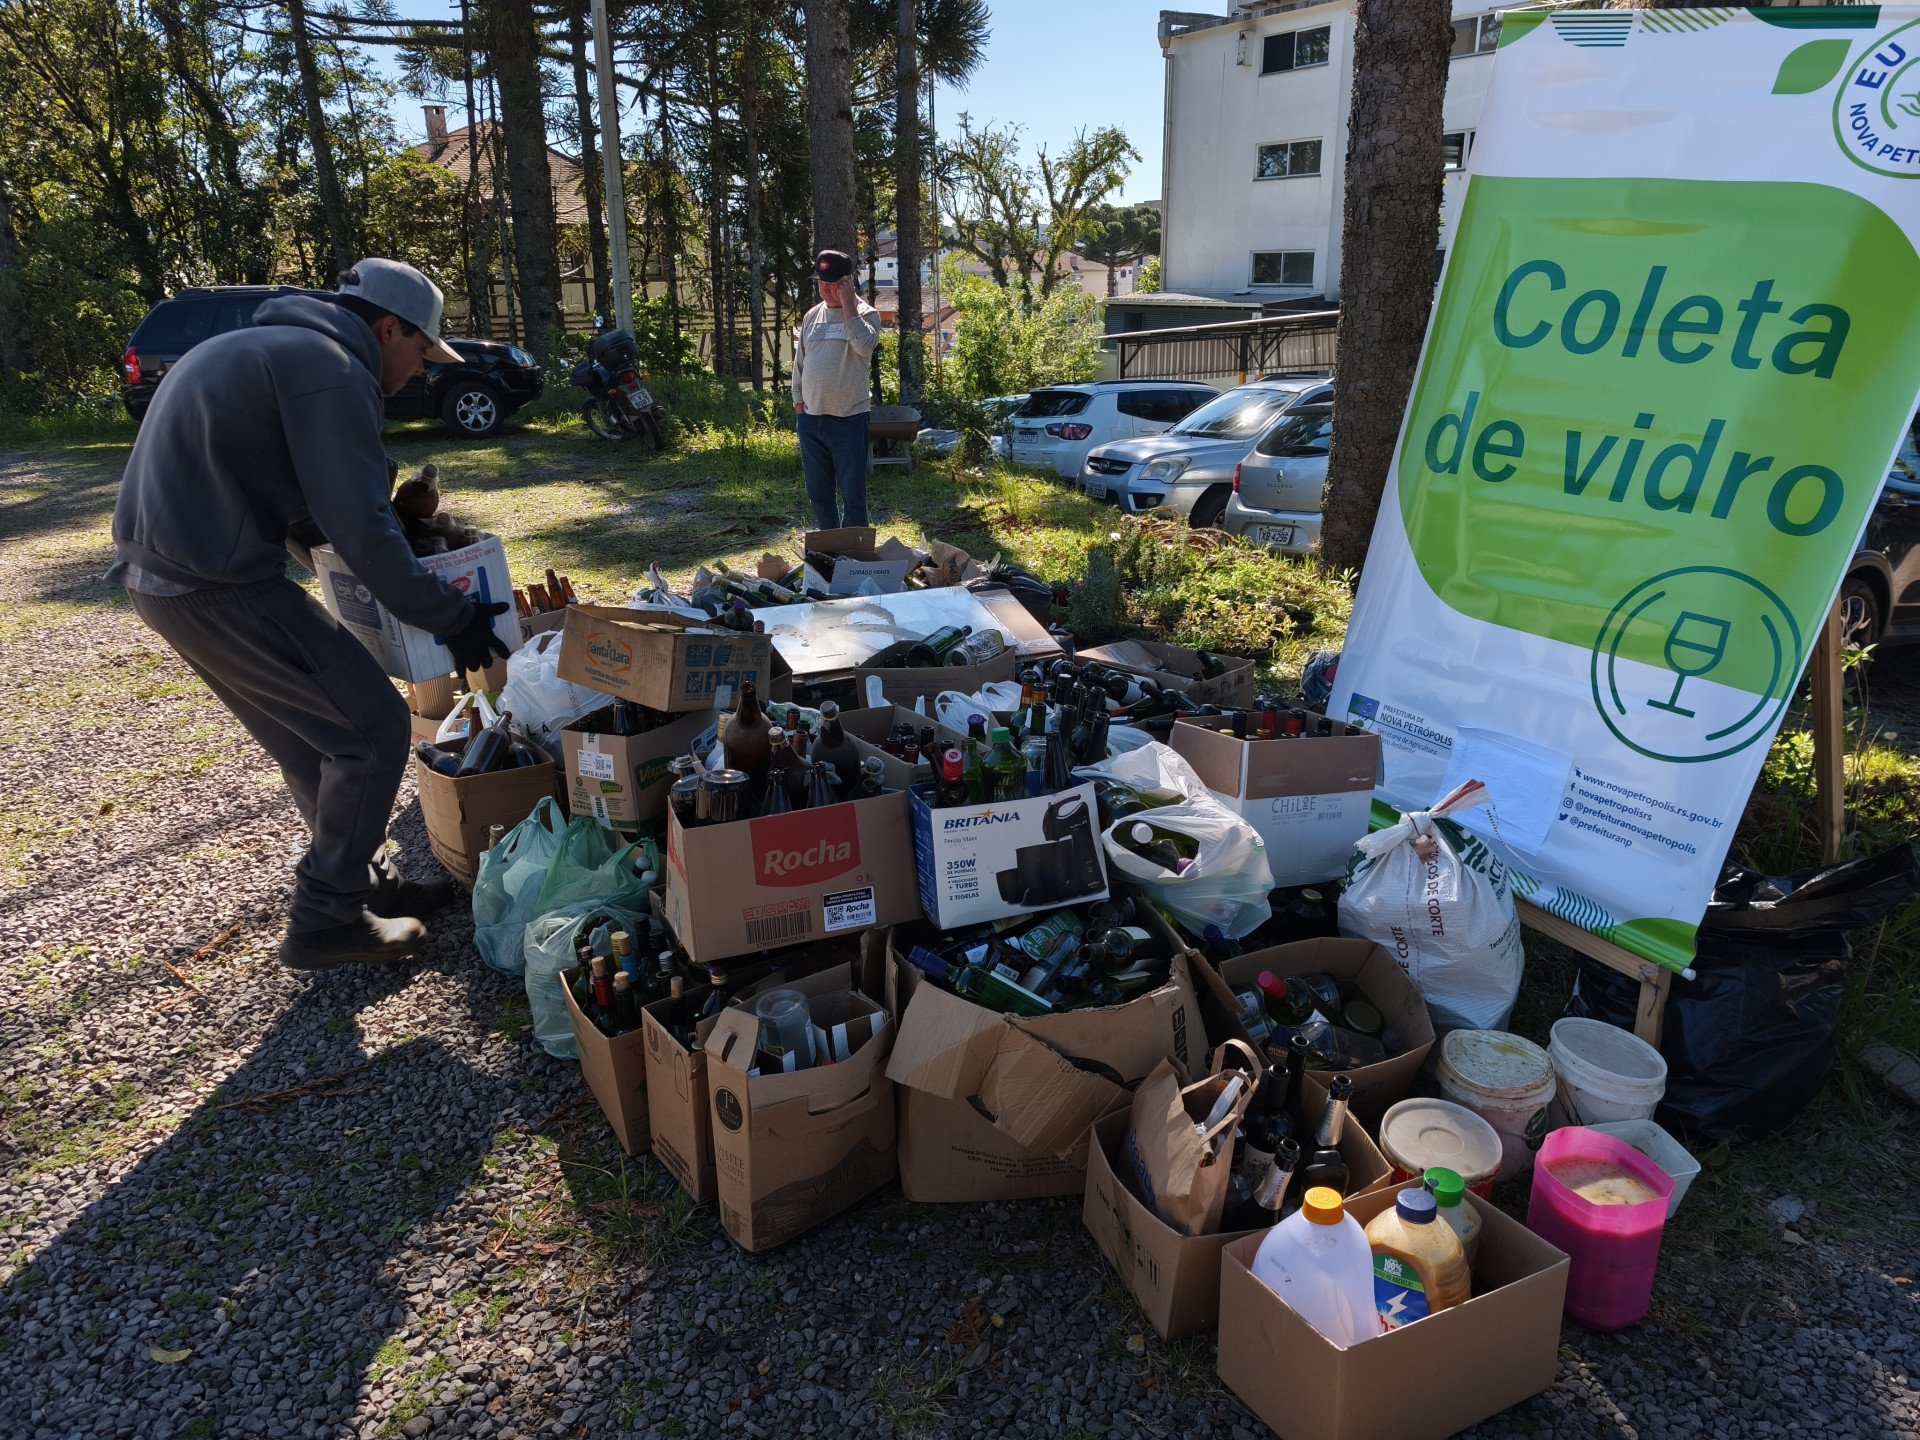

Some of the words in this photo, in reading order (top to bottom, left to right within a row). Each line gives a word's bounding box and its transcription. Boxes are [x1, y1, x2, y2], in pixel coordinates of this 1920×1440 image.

[1855, 42, 1906, 89] EU
[1850, 103, 1879, 151] NOVA
[1877, 143, 1920, 164] PET
[1493, 259, 1851, 380] Coleta
[1424, 391, 1525, 483] de
[1563, 413, 1845, 537] vidro
[588, 642, 608, 659] Santa
[608, 648, 630, 665] Clara
[1380, 712, 1402, 727] NOVA
[1403, 720, 1453, 747] PETRÓPOLIS
[1383, 704, 1416, 721] PREFEITURA
[1416, 716, 1425, 725] DE
[1377, 727, 1401, 742] Secretaria
[1408, 739, 1438, 755] Agricultura
[1391, 740, 1416, 755] Ambiente
[580, 769, 594, 777] PORTO
[1578, 787, 1653, 822] novapetropolisrs
[1583, 773, 1724, 829] www.novapetropolis.rs.gov.br
[1569, 816, 1633, 848] @prefeituranp
[1575, 802, 1697, 855] @prefeituranovapetropolis
[763, 838, 852, 876] Rocha
[946, 858, 977, 870] 350W
[955, 881, 979, 889] TURBO
[955, 892, 980, 900] TIGELAS
[1427, 883, 1439, 896] DE
[846, 902, 870, 913] Rocha
[1427, 898, 1444, 937] CORTE
[1391, 926, 1410, 959] CORTE
[716, 1141, 745, 1170] VISITE
[1384, 1259, 1402, 1271] 100%
